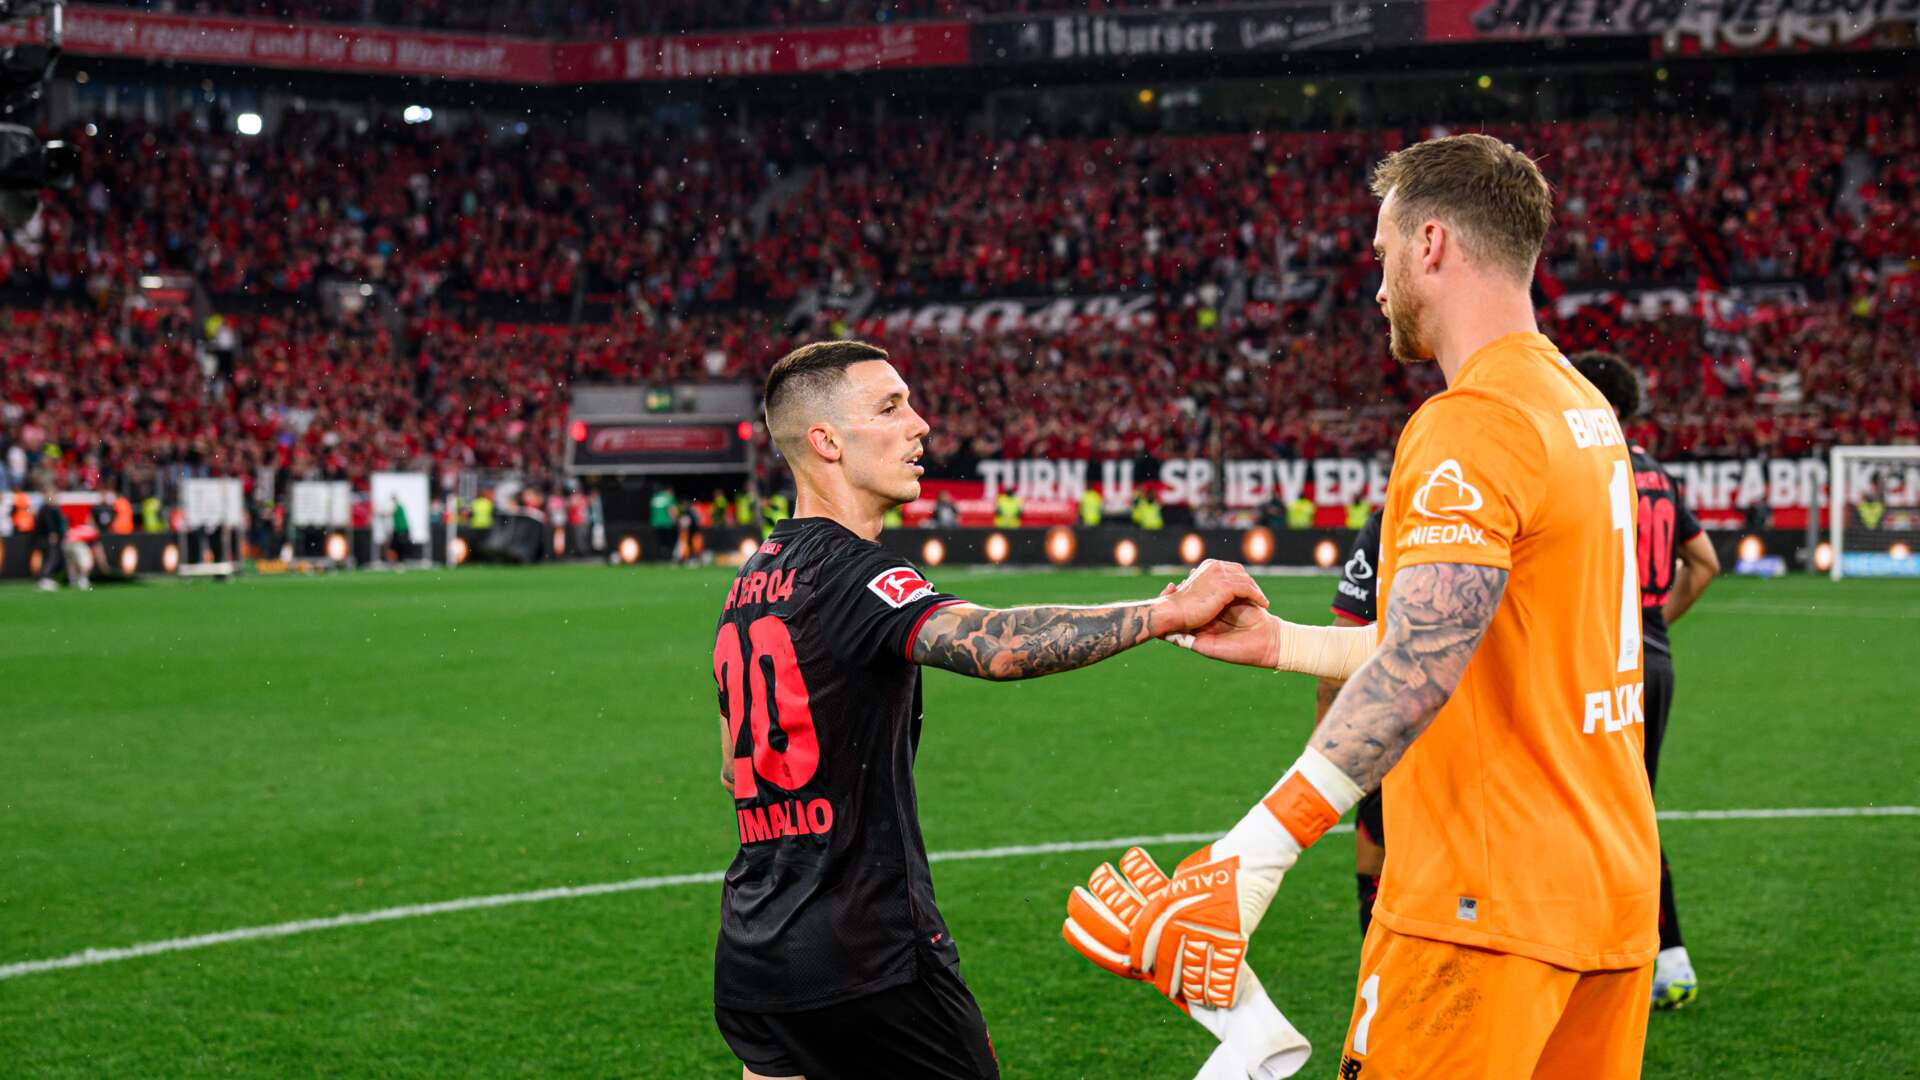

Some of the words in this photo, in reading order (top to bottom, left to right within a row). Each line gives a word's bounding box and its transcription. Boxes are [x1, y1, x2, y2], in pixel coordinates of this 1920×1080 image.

[1407, 523, 1488, 548] NIEDAX
[1608, 460, 1641, 672] 1
[713, 615, 820, 799] 20
[1353, 973, 1381, 1056] 1
